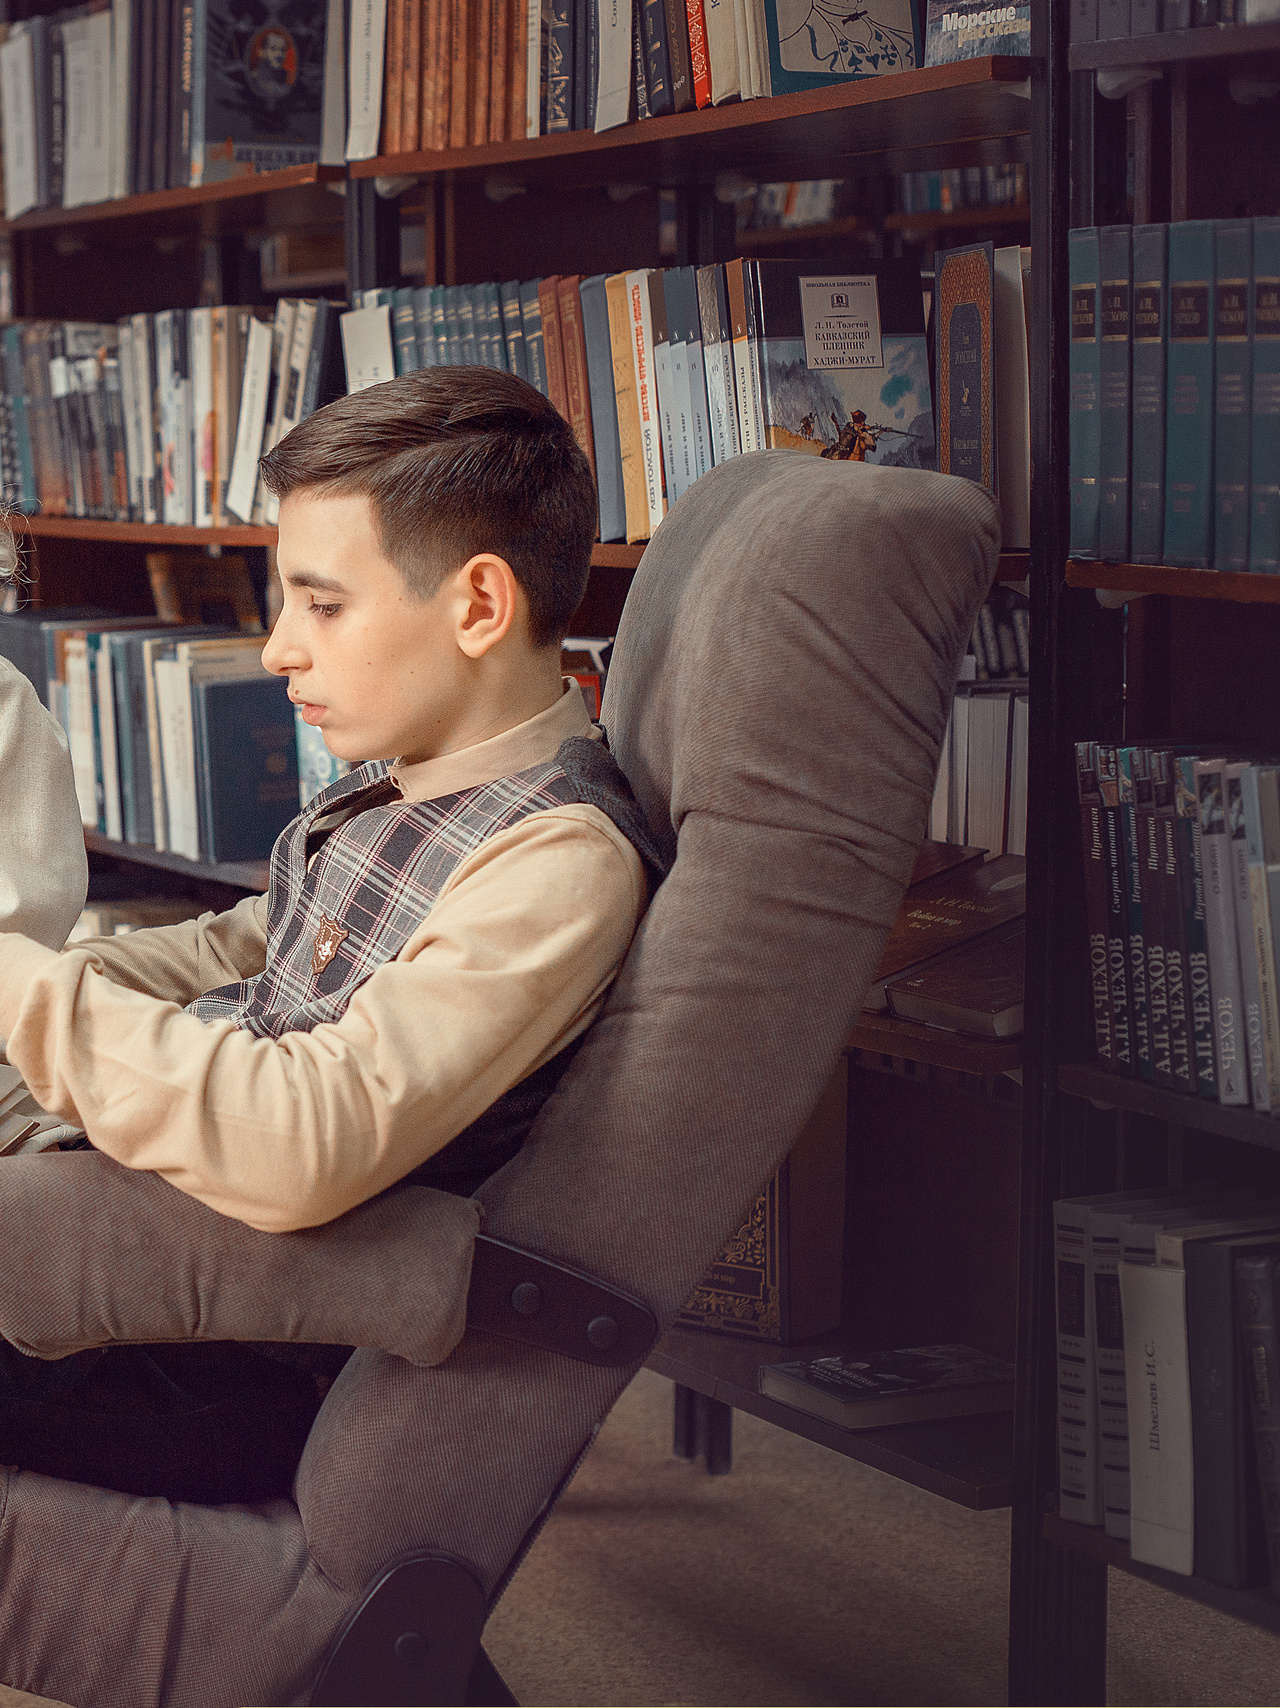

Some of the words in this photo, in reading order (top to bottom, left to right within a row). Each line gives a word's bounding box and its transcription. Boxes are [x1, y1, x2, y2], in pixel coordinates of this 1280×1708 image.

[942, 6, 1016, 33] Морские
[815, 330, 871, 341] КАВКАЗСКИЙ
[822, 341, 865, 351] ПЛЕННИК
[836, 320, 869, 328] Толстой
[813, 355, 877, 366] ХАДЖИ-МУРАТ
[642, 428, 655, 485] ТОЛСТОЙ
[649, 485, 657, 511] ЛЕВ
[1091, 934, 1109, 1008] ЧЕХОВ
[1108, 938, 1126, 1013] ЧЕХОВ
[1130, 934, 1146, 1010] ЧЕХОВ
[1147, 945, 1167, 1023] ЧЕХОВ
[1167, 950, 1186, 1028] ЧЕХОВ
[1189, 952, 1211, 1030] ЧЕХОВ
[1095, 1011, 1111, 1058] А.П.
[1115, 1015, 1131, 1063] А.П.
[1153, 1025, 1171, 1073] А.П.
[1173, 1030, 1190, 1080] А.П.
[1195, 1032, 1214, 1082] А.П.
[1218, 997, 1236, 1071] ЧЕХОВ
[1246, 1003, 1263, 1075] ЧЕХОВ
[1144, 1340, 1156, 1378] И.С.
[1149, 1382, 1160, 1451] Шмелев
